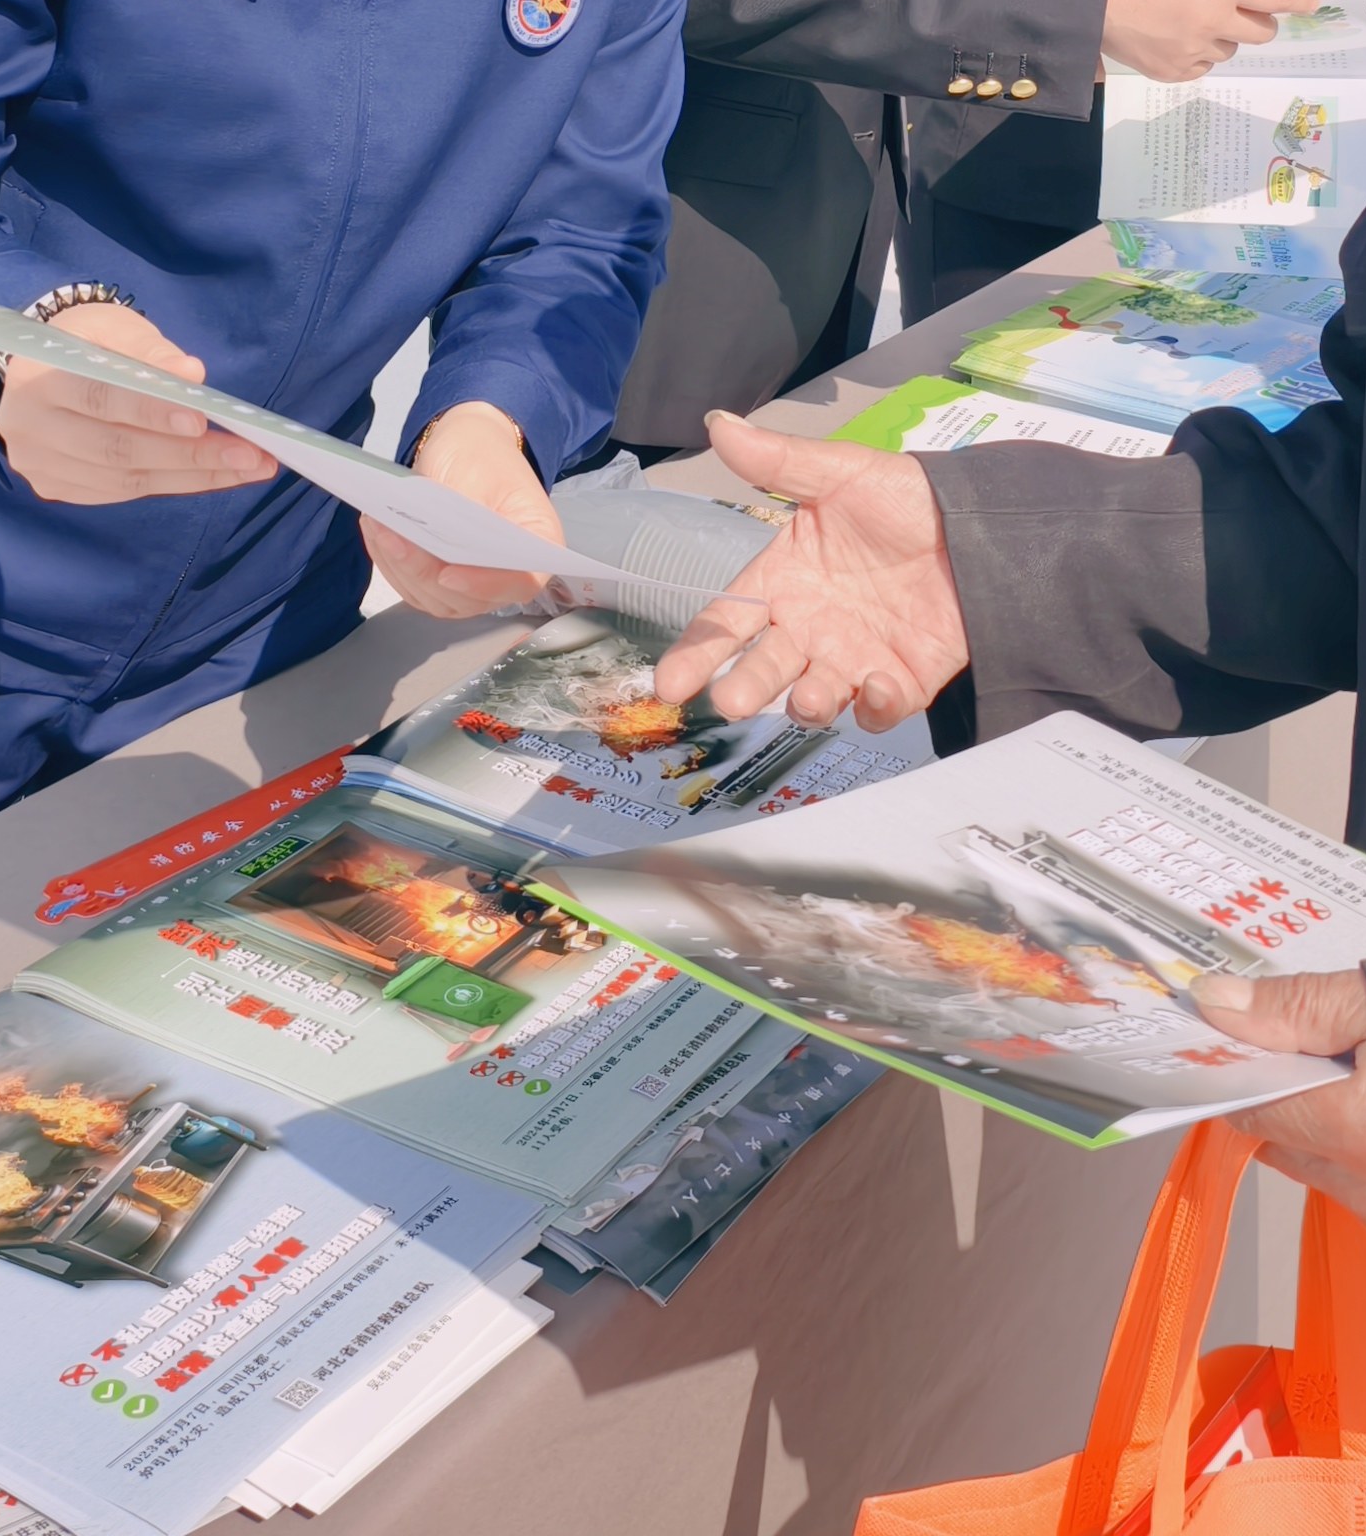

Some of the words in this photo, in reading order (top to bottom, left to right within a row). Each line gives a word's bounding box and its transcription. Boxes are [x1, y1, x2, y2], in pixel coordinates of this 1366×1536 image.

[149, 819, 245, 868] 消防安全
[269, 772, 334, 812] 从我做
[157, 917, 372, 1015] 封死逃生的希望
[173, 971, 355, 1054] 别让随意堆放
[518, 952, 662, 1069] 电动自行车不进楼入
[542, 963, 681, 1080] 时刻保持生命通道畅
[90, 1201, 306, 1362] 不私自改装燃气线路
[123, 1235, 310, 1378] 厨房用火有人看管
[154, 1202, 397, 1393] 经常检查燃气设施和用具
[311, 1279, 435, 1382] 河北省消防救援总队
